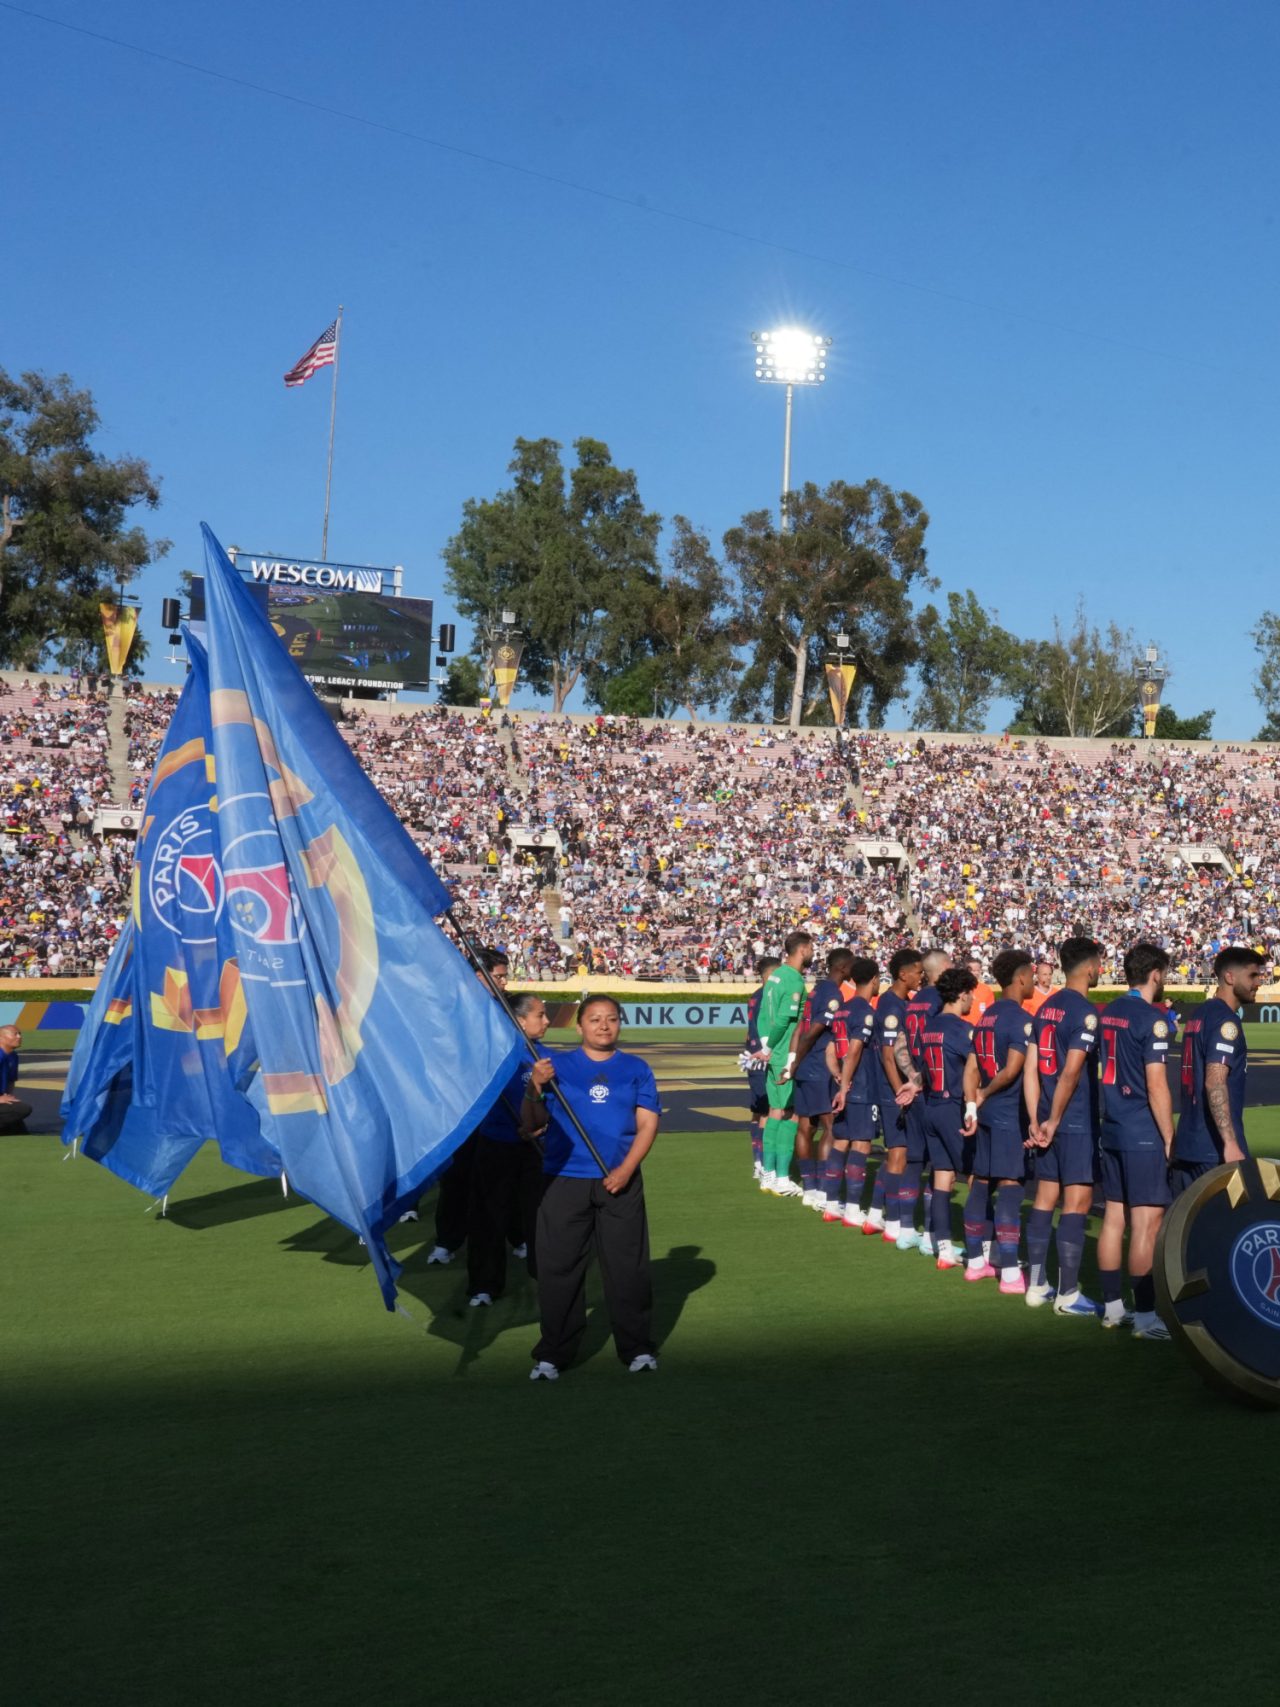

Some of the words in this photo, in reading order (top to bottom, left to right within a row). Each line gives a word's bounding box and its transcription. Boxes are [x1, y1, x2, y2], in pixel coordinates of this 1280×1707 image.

[251, 560, 354, 589] WESCOM
[328, 676, 355, 686] LEGACY
[358, 678, 403, 689] FOUNDATION
[154, 815, 200, 907] PARIS
[620, 1006, 676, 1025] ANK
[685, 1006, 721, 1025] OF
[1039, 1023, 1058, 1076] 9
[1102, 1029, 1117, 1085] 7
